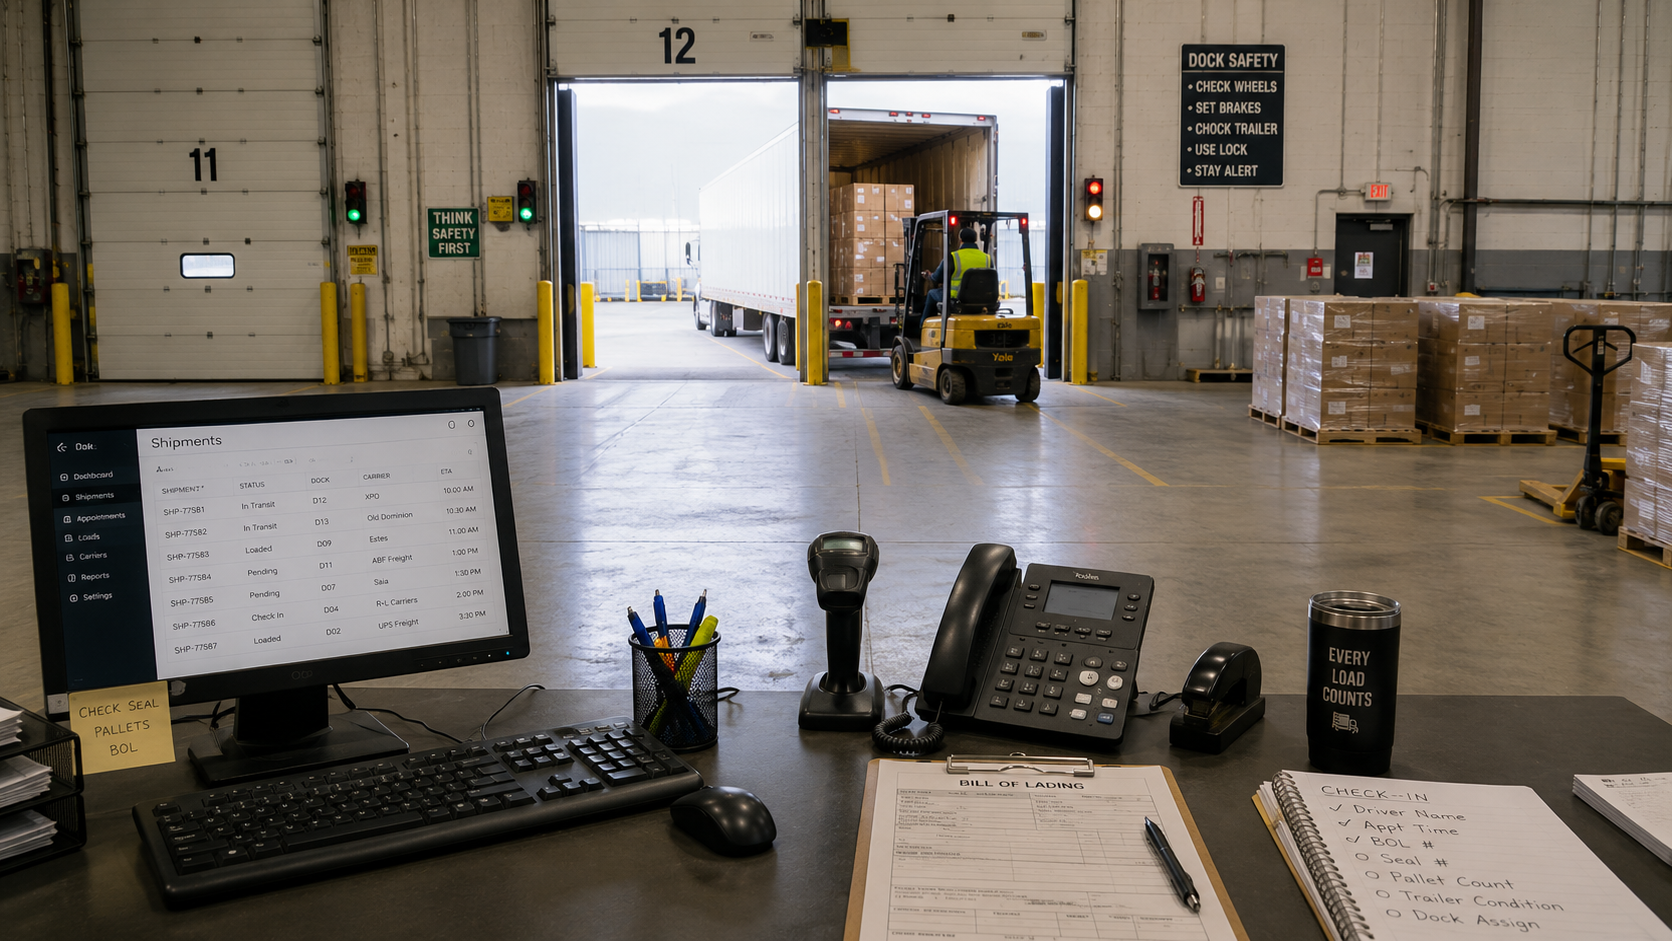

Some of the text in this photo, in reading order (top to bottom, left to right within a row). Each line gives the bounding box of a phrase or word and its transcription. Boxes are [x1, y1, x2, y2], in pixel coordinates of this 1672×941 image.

[658, 27, 696, 64] 12
[1188, 52, 1278, 68] DOCK SAFETY
[1196, 80, 1278, 92] CHECK WHEELS
[1196, 102, 1262, 114] SET BRAKES
[1195, 122, 1278, 135] CHOCK TRAILER
[1195, 144, 1248, 156] USE LOCK
[189, 148, 218, 182] 11
[1194, 164, 1258, 177] STAY ALERT
[1370, 184, 1389, 198] EXIT
[433, 212, 473, 224] THINK
[432, 228, 475, 240] SAFETY
[438, 242, 470, 254] FIRST
[151, 435, 222, 450] Shipments
[76, 492, 114, 501] Shipments
[251, 501, 275, 509] Transit
[381, 512, 413, 520] Dominion
[252, 523, 277, 531] Transit
[245, 545, 272, 554] Loaded
[372, 556, 386, 564] ABF
[81, 572, 110, 581] Reports
[247, 568, 278, 576] Pending
[83, 592, 113, 602] Settings
[249, 590, 280, 598] Pending
[390, 597, 418, 605] Carriers
[252, 612, 275, 621] Check
[395, 619, 419, 628] Freight
[254, 635, 281, 644] Loaded
[1329, 646, 1371, 666] EVERY
[1332, 668, 1365, 687] LOAD
[1322, 686, 1372, 707] COUNTS
[79, 698, 159, 718] CHECK SEAL
[94, 720, 150, 738] PALLETS
[110, 742, 138, 756] BOL
[959, 779, 1085, 790] BILL OF LADING
[1353, 804, 1467, 822] Driver Name
[1364, 820, 1460, 836] Appt Time
[1371, 836, 1435, 850] BOL #
[1381, 854, 1449, 868] Seal #
[1390, 871, 1515, 891] Pallet Count
[1399, 890, 1564, 912] Trailer Condition
[1412, 909, 1540, 931] Dock Assign
